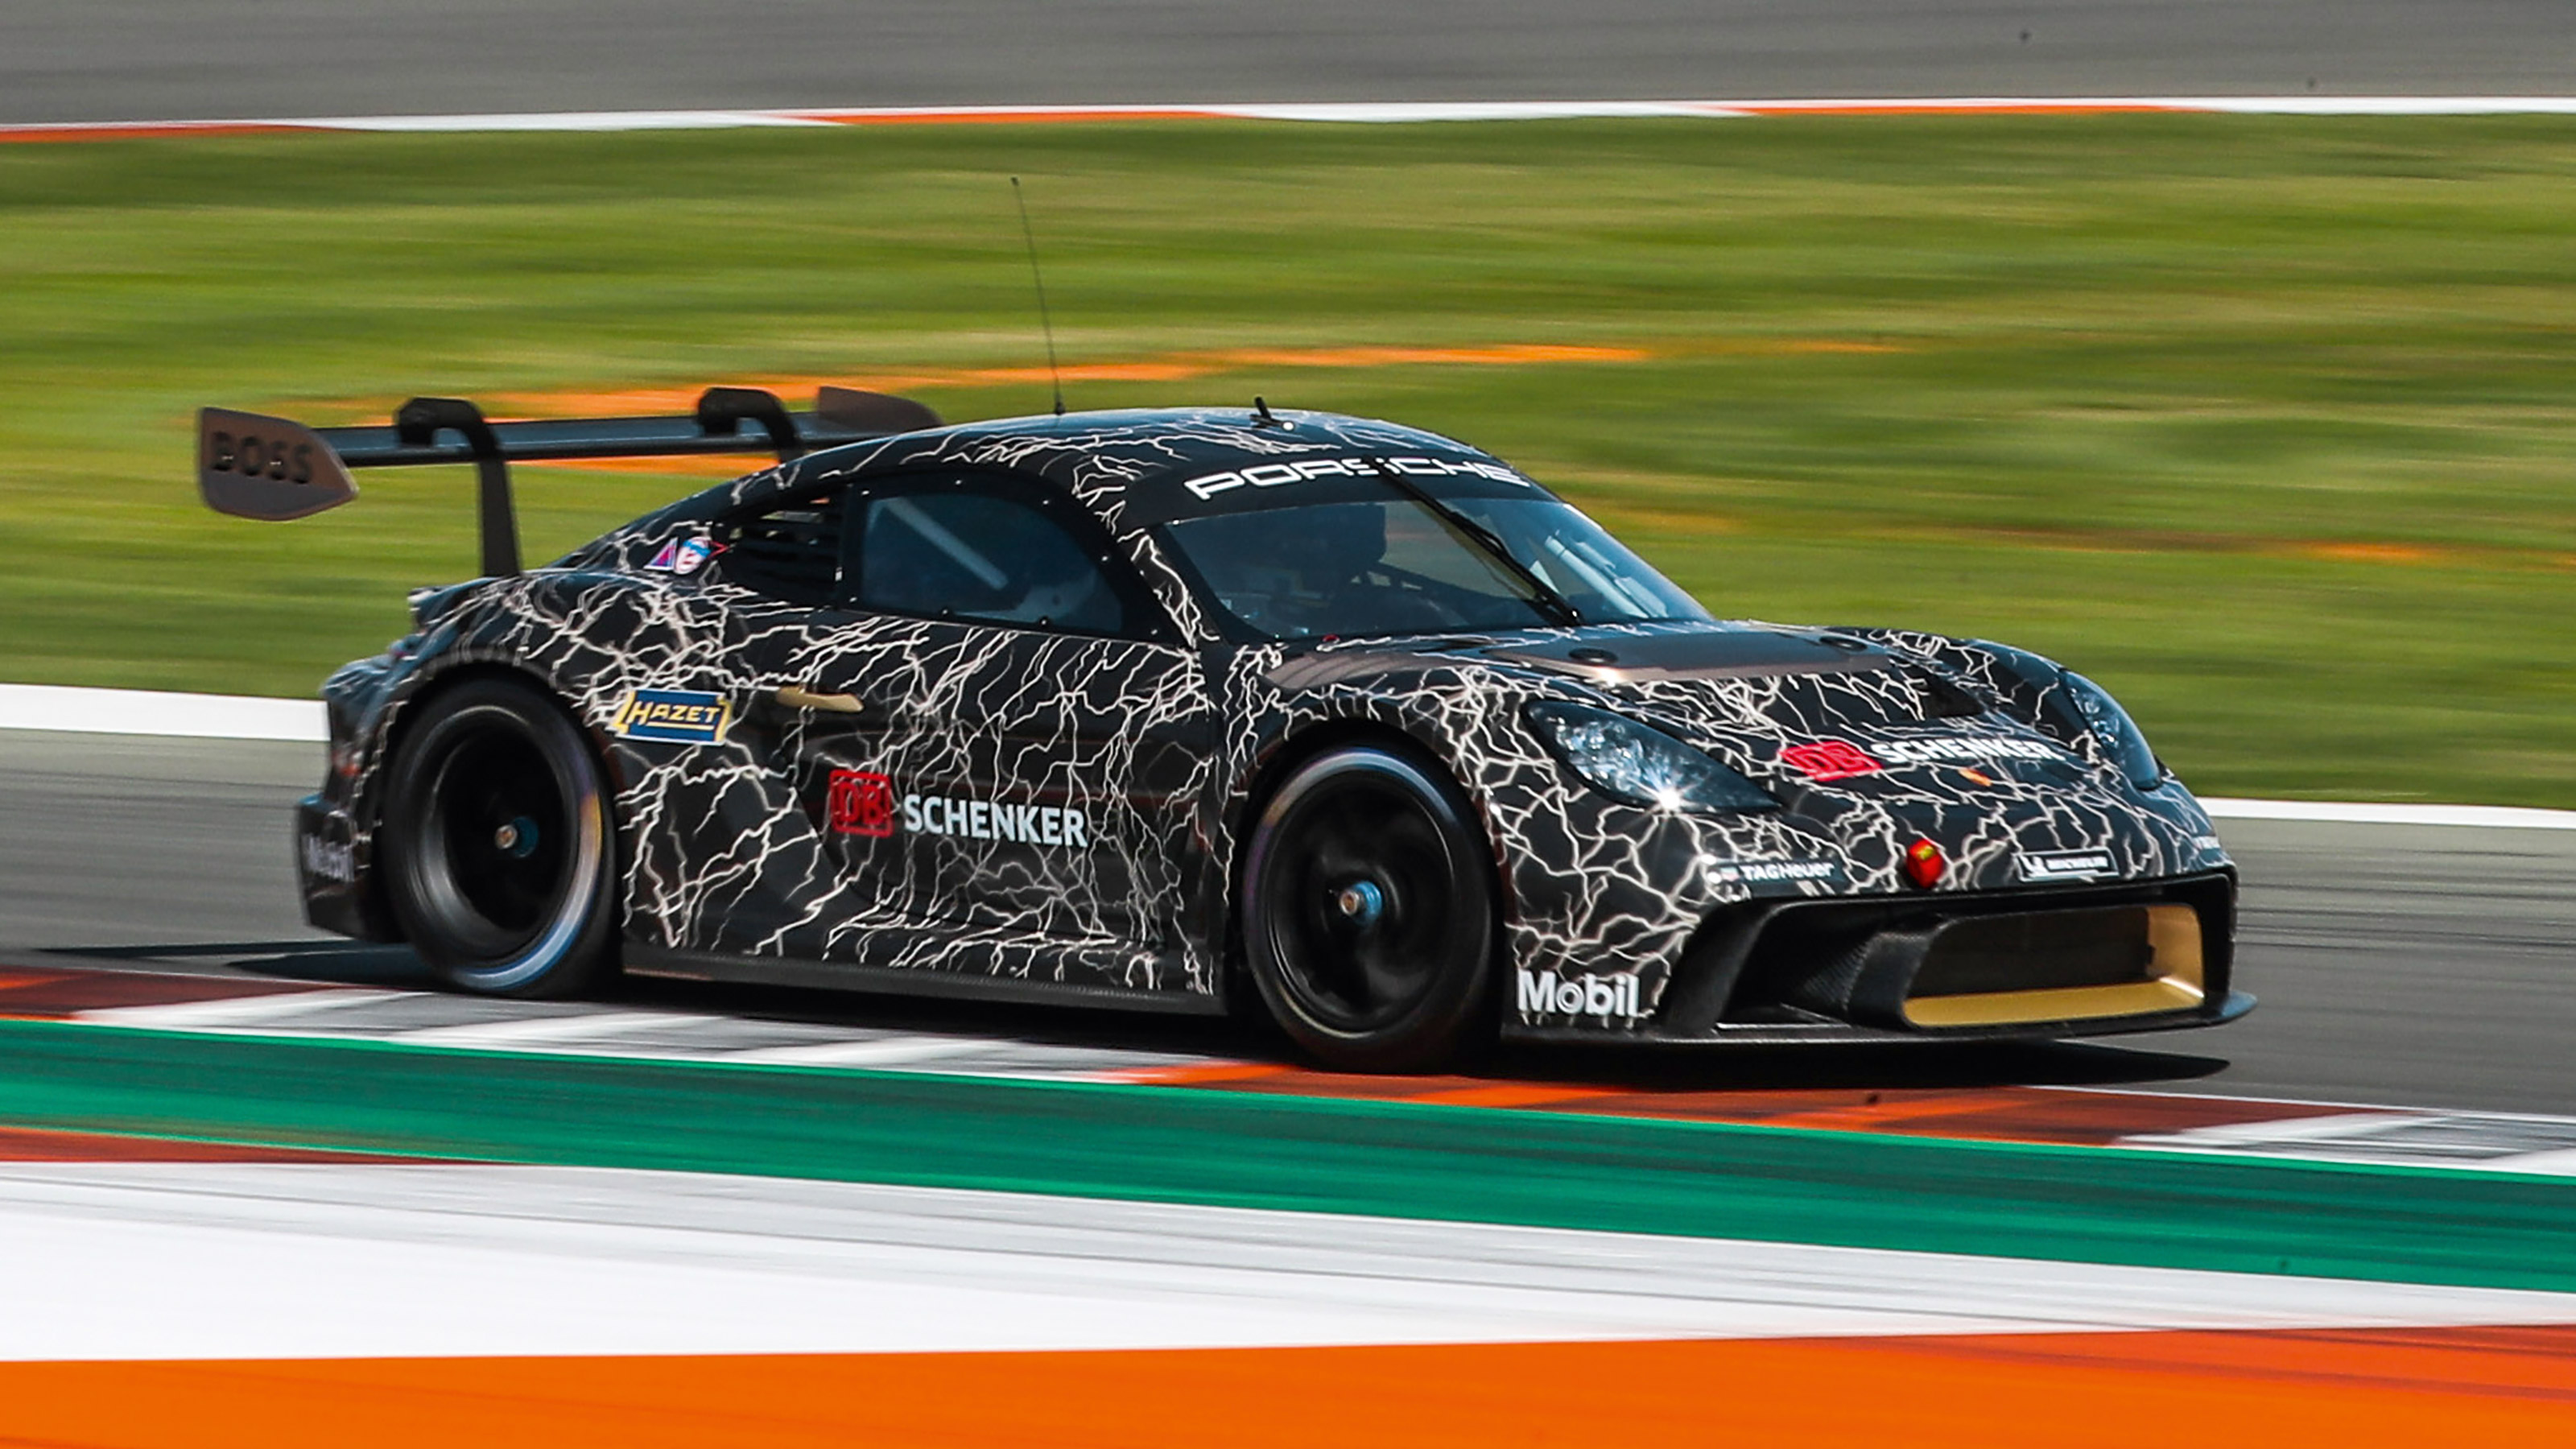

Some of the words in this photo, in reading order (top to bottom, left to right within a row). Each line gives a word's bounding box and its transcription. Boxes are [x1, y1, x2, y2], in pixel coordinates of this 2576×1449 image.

[212, 431, 313, 485] BOSS
[1184, 456, 1531, 501] PORSCHE
[626, 700, 720, 724] HAZET
[1871, 737, 2066, 764] SCHENKER
[838, 781, 885, 826] DB
[904, 794, 1088, 848] SCHENKER
[1518, 970, 1639, 1017] Mobil
